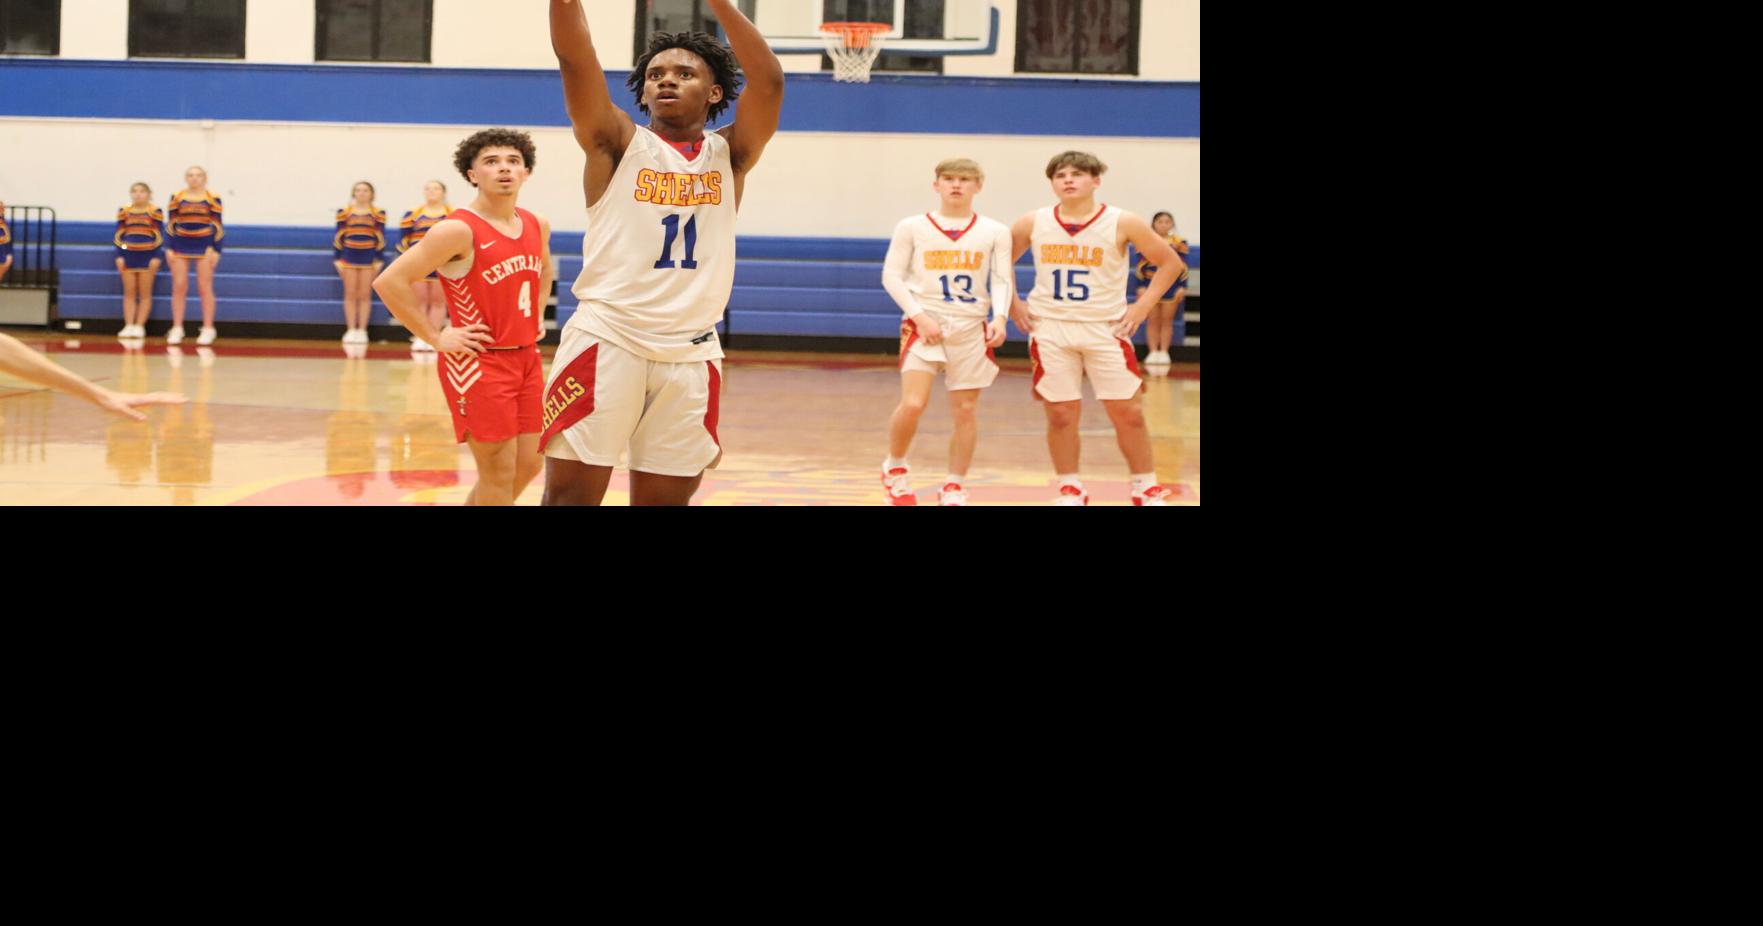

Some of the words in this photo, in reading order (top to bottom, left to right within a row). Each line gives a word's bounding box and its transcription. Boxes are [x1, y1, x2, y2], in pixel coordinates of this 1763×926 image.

[634, 168, 722, 206] SHELLS
[653, 213, 698, 269] 11
[1040, 244, 1104, 267] SHELLS
[923, 250, 984, 271] SHELLS
[518, 281, 531, 318] 4
[939, 274, 976, 303] 13
[1051, 269, 1090, 301] 15
[541, 376, 585, 436] HELLS
